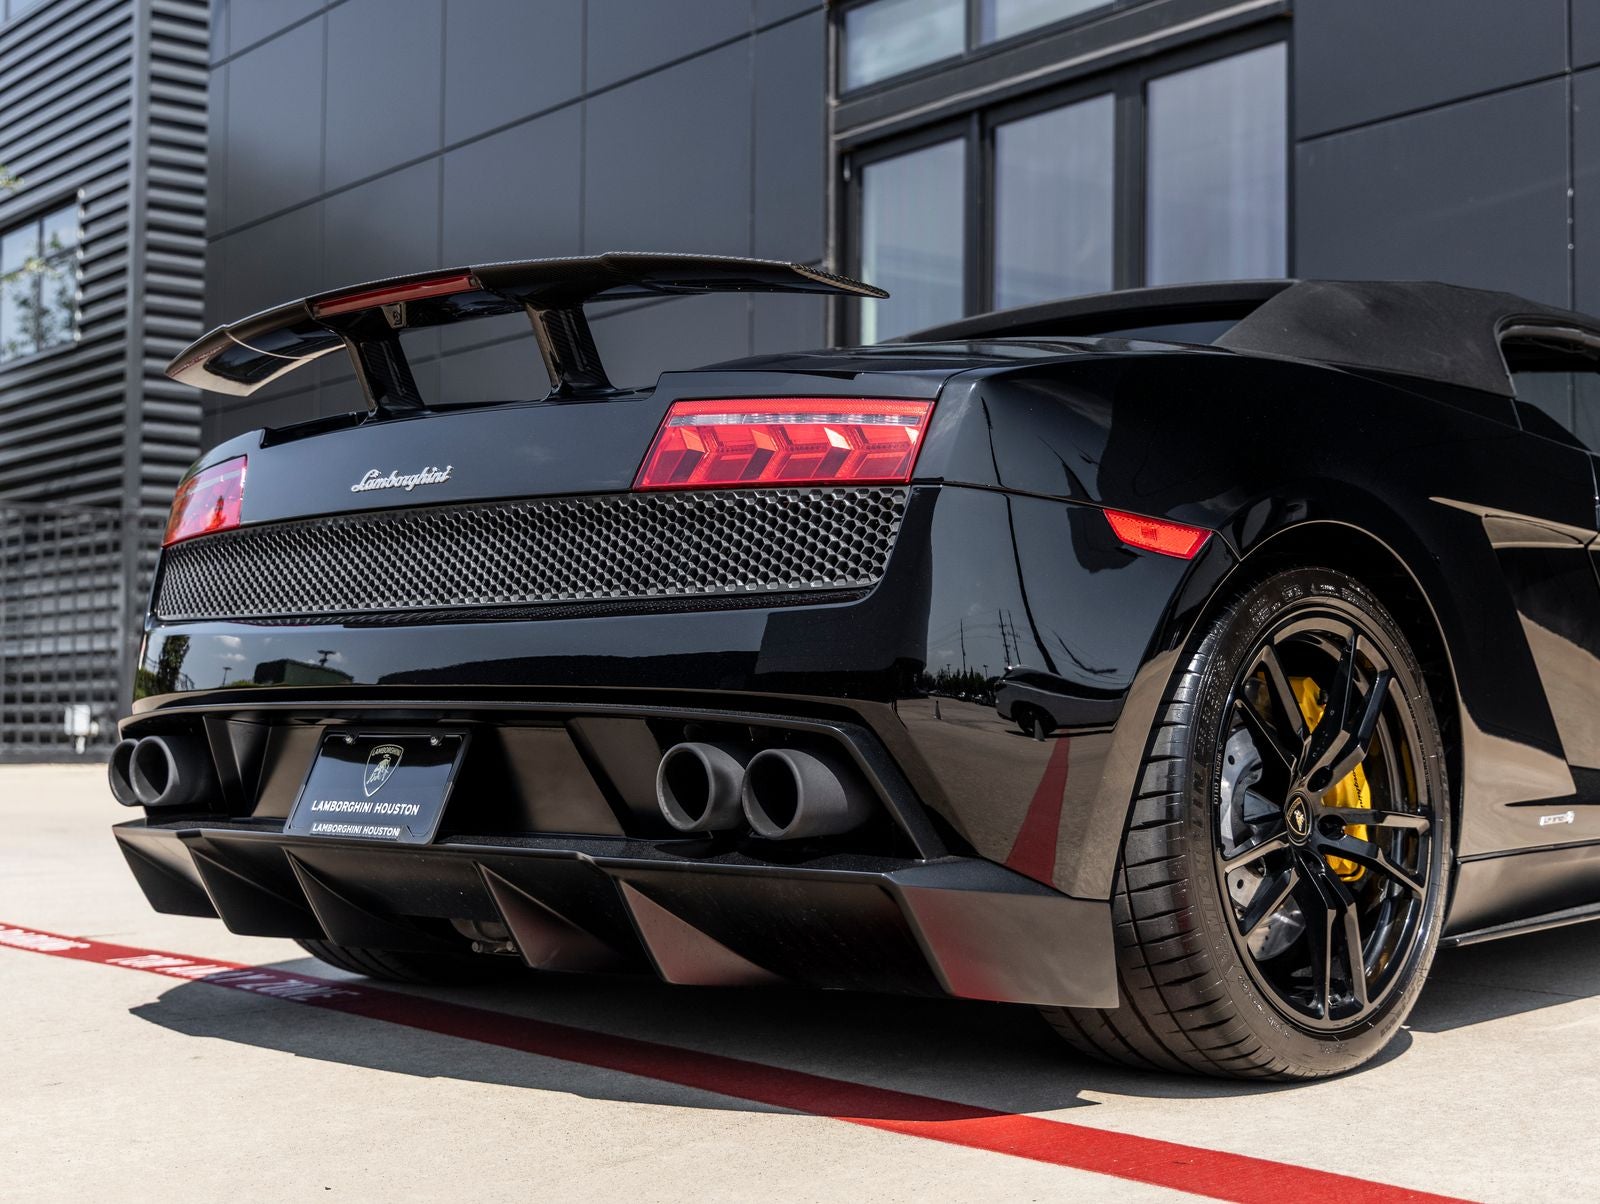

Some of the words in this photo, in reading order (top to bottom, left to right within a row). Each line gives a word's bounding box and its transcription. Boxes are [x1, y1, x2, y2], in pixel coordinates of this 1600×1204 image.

[351, 465, 454, 492] Lamborghini
[311, 800, 374, 813] LAMBORGHINI
[373, 802, 420, 815] HOUSTON
[312, 823, 363, 834] LAMBORGHINI
[362, 826, 400, 836] HOUSTON
